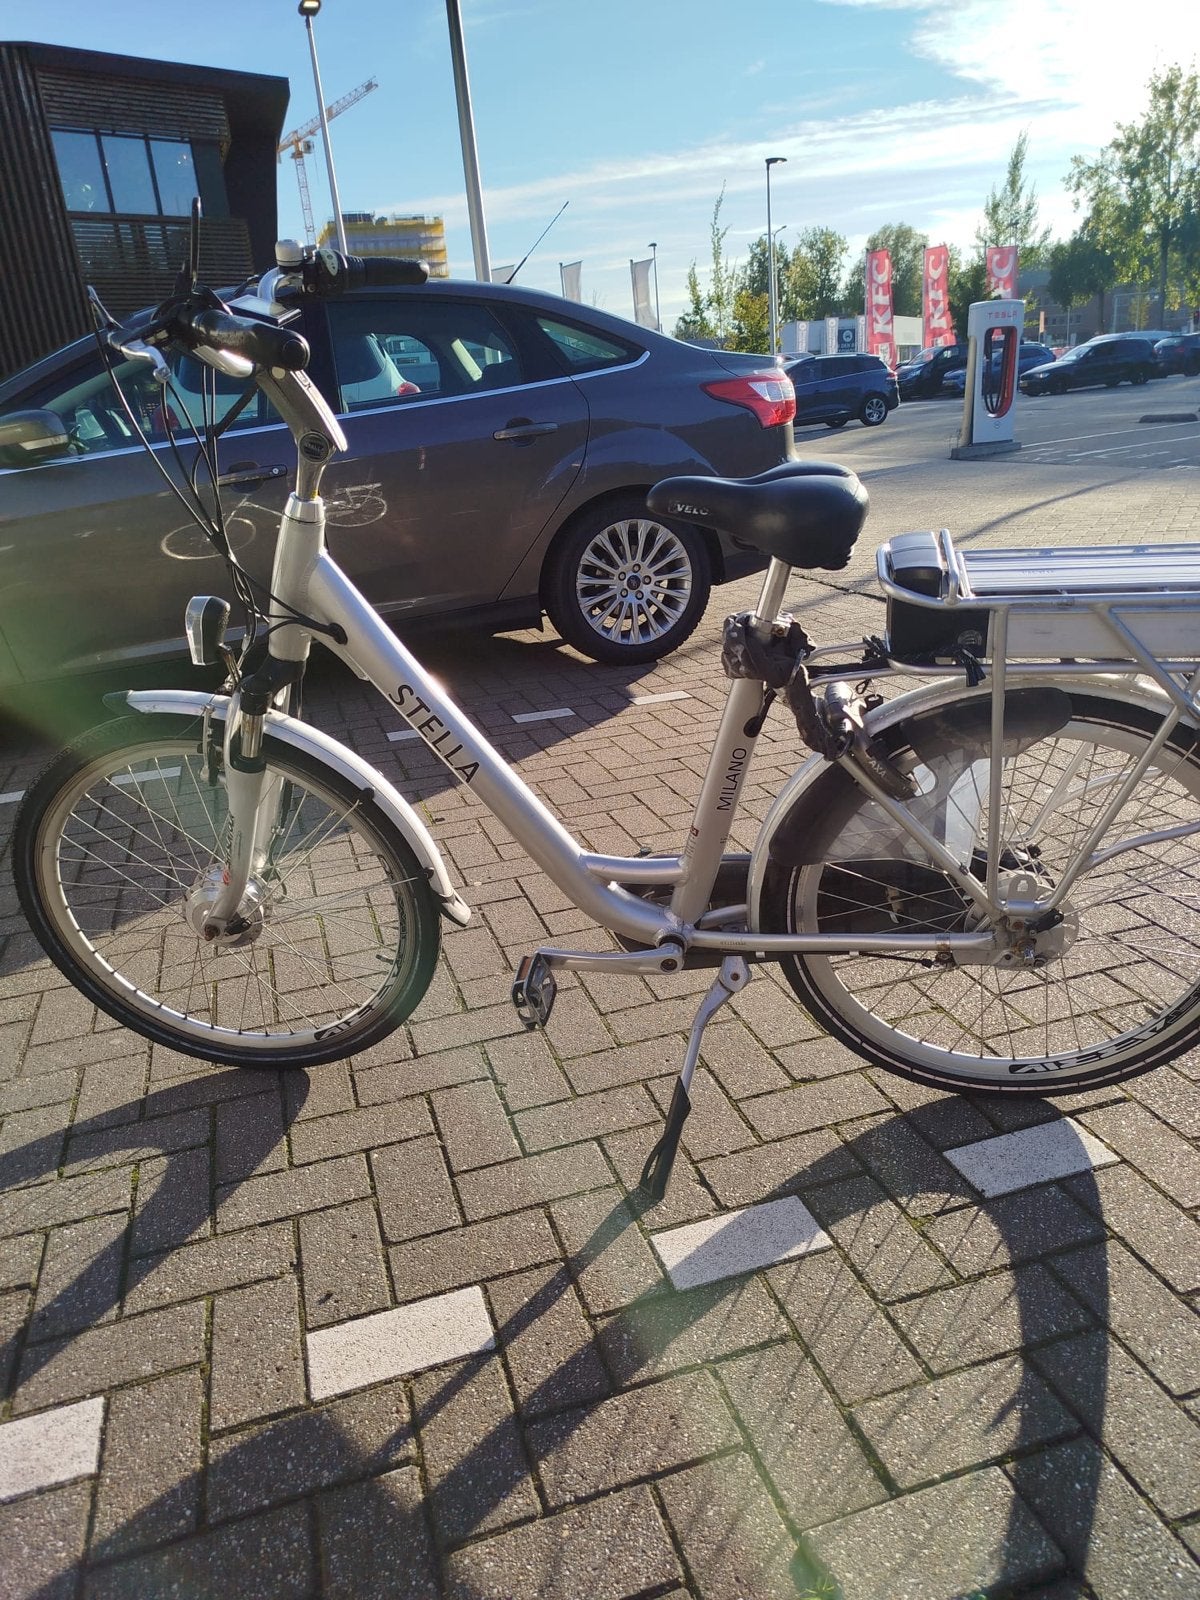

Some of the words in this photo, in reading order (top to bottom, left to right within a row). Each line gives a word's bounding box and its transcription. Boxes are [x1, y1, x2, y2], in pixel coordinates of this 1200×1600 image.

[871, 258, 893, 336] KFC
[927, 254, 949, 330] KFC
[987, 311, 1018, 319] TESLA
[388, 684, 480, 784] STELLA
[868, 760, 887, 777] AXA
[716, 748, 747, 811] MILANO
